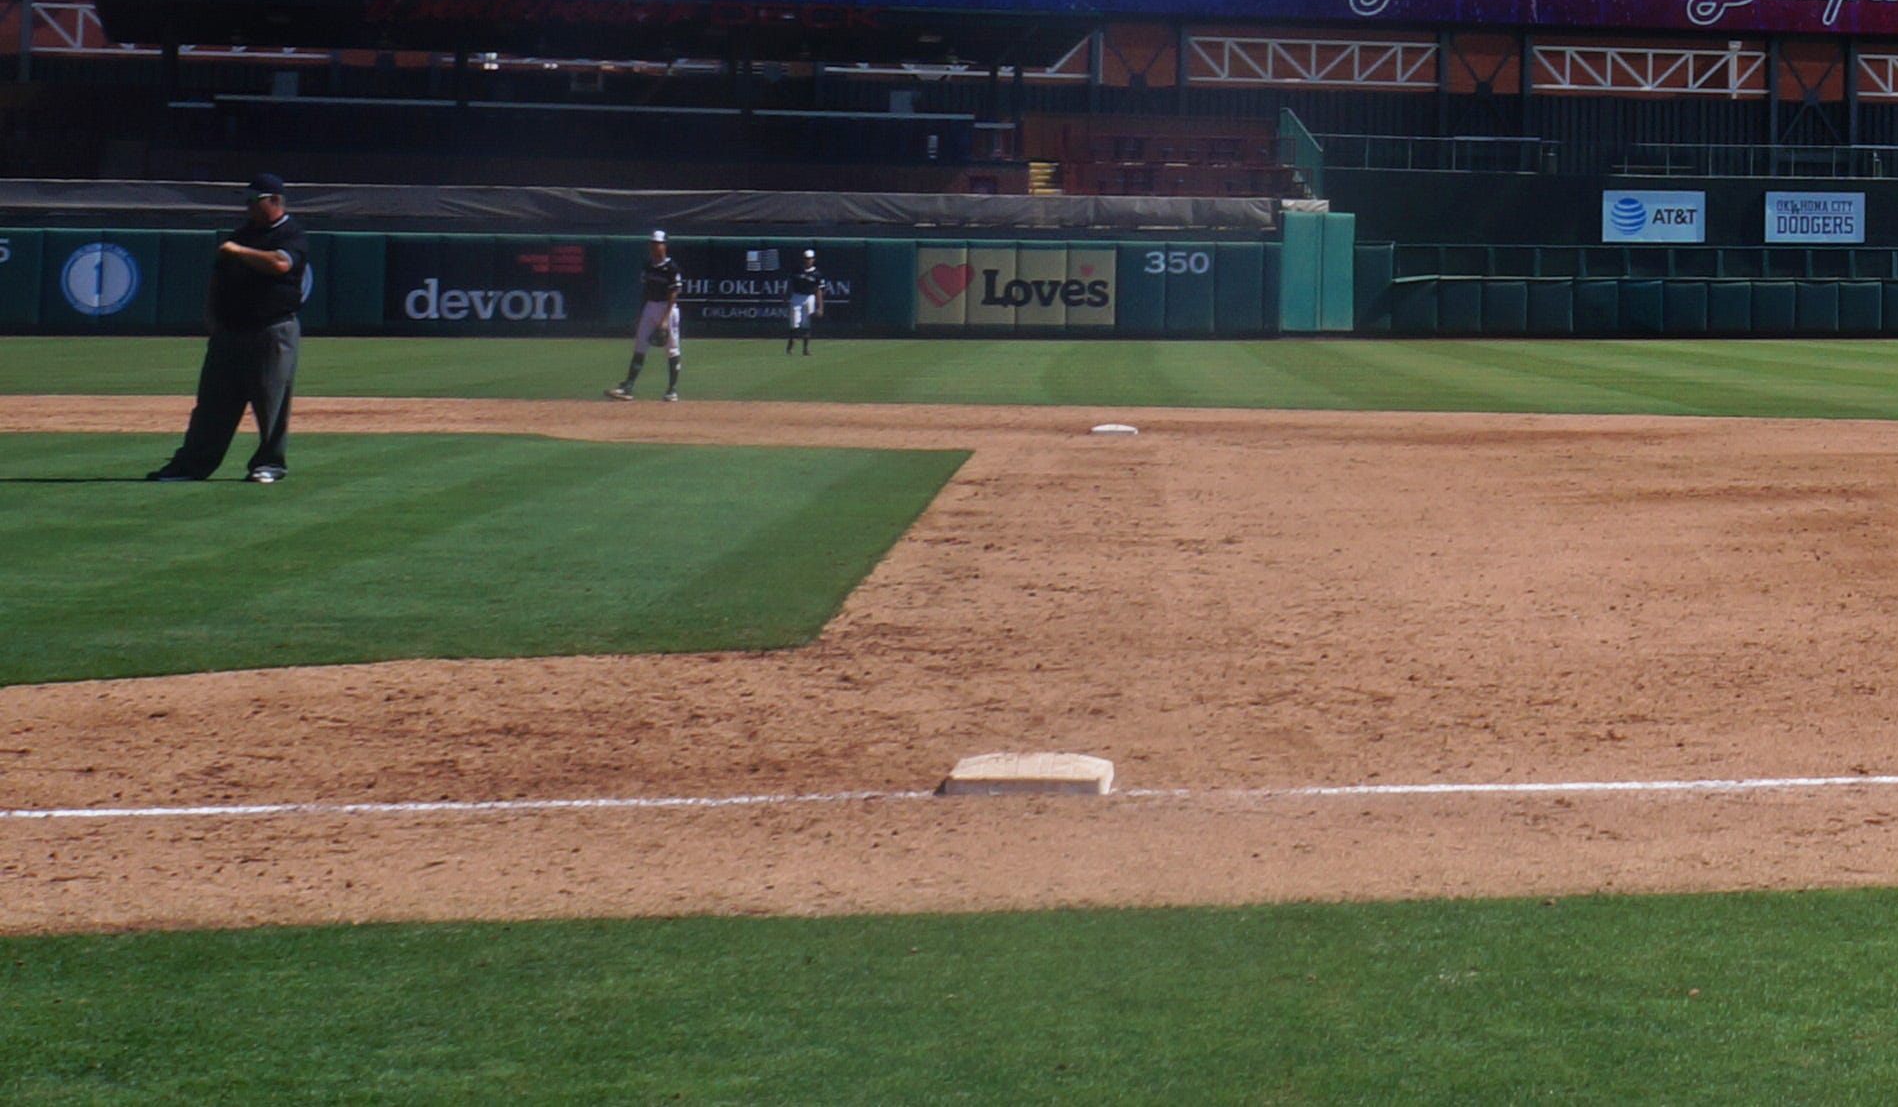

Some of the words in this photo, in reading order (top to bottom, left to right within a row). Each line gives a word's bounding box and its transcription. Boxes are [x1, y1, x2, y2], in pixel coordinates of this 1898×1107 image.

[1831, 200, 1853, 212] CITY
[1652, 208, 1698, 225] AT&T
[1777, 215, 1855, 234] DODGERS
[1144, 251, 1210, 274] 350
[719, 278, 850, 295] OKLAHAN
[405, 278, 567, 320] devon
